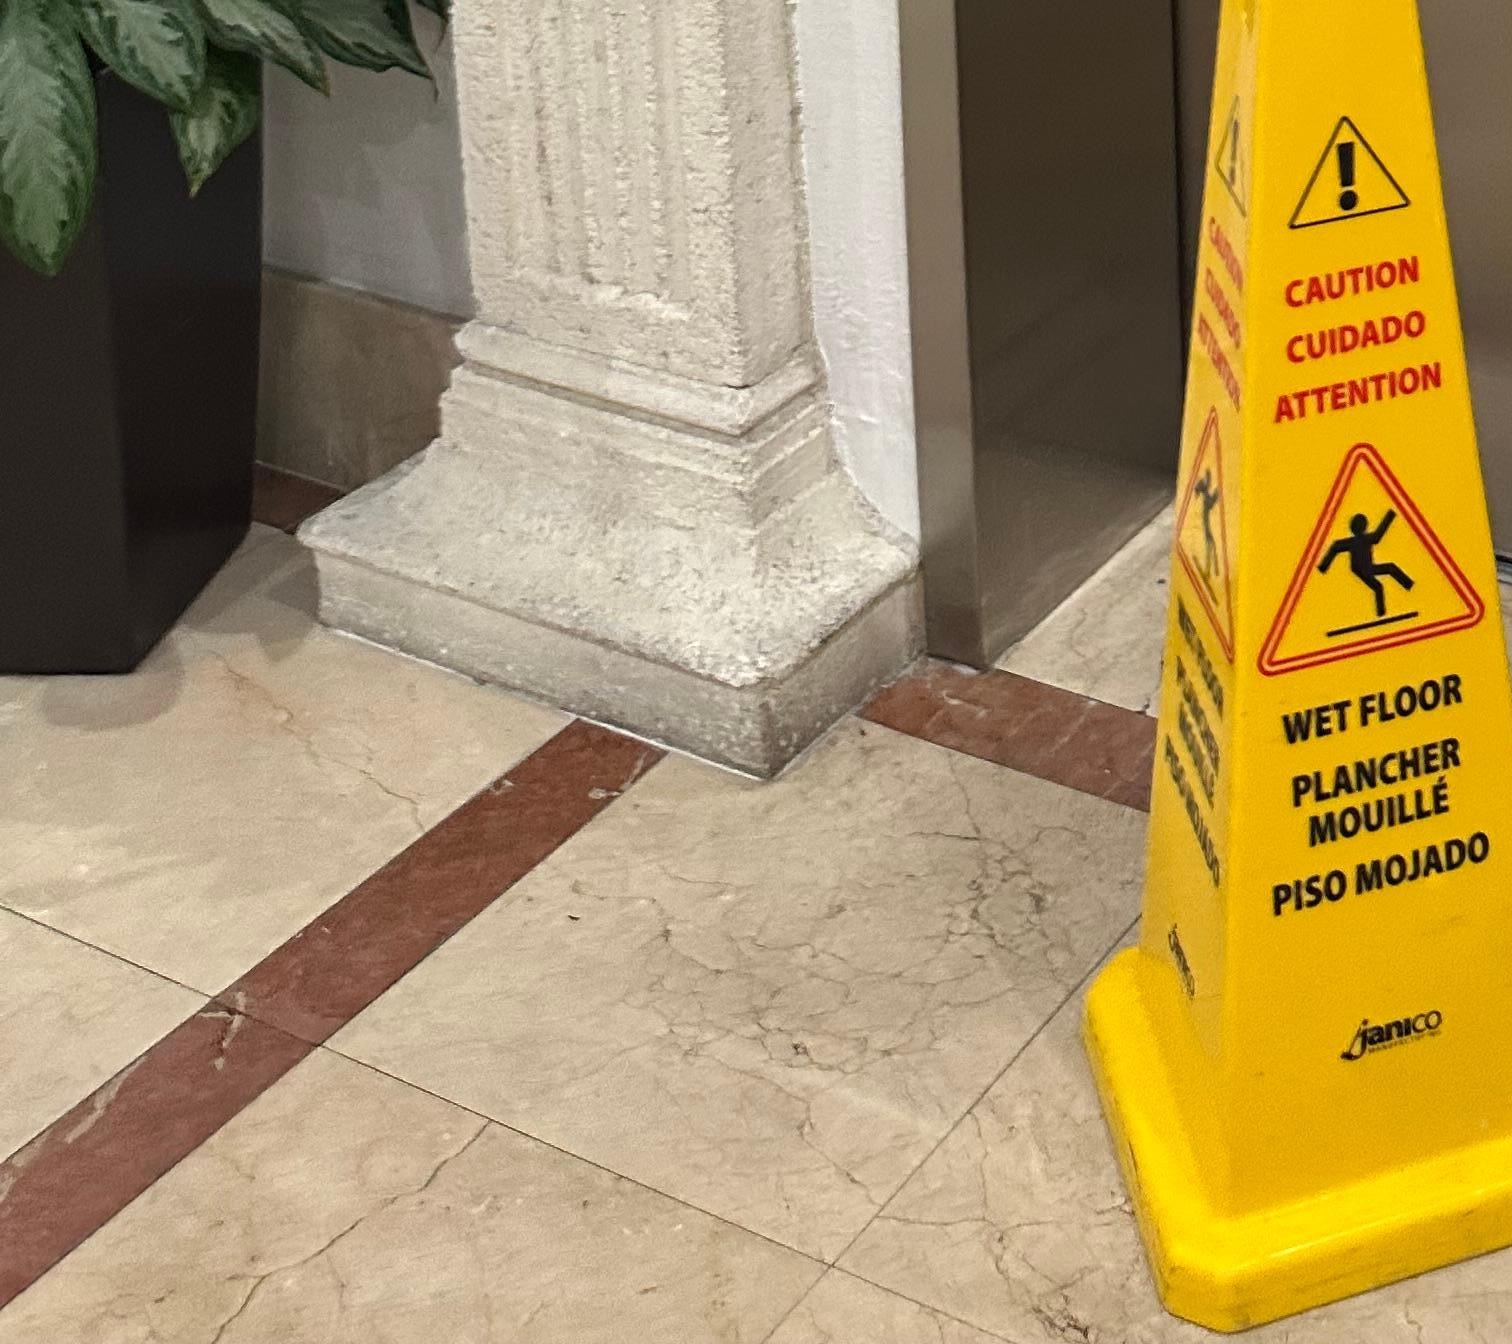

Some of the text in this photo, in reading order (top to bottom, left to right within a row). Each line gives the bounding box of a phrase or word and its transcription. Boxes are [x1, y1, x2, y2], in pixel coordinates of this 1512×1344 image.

[1284, 255, 1420, 308] CAUTION
[1286, 310, 1426, 364] CUIDADO
[1274, 363, 1441, 423] ATTENTION
[1281, 699, 1352, 745] WET
[1360, 673, 1463, 729] FLOOR
[1291, 737, 1461, 807] PLANCHER
[1308, 775, 1450, 848] MOUILLÉ
[1272, 831, 1491, 916] PISO MOJADO
